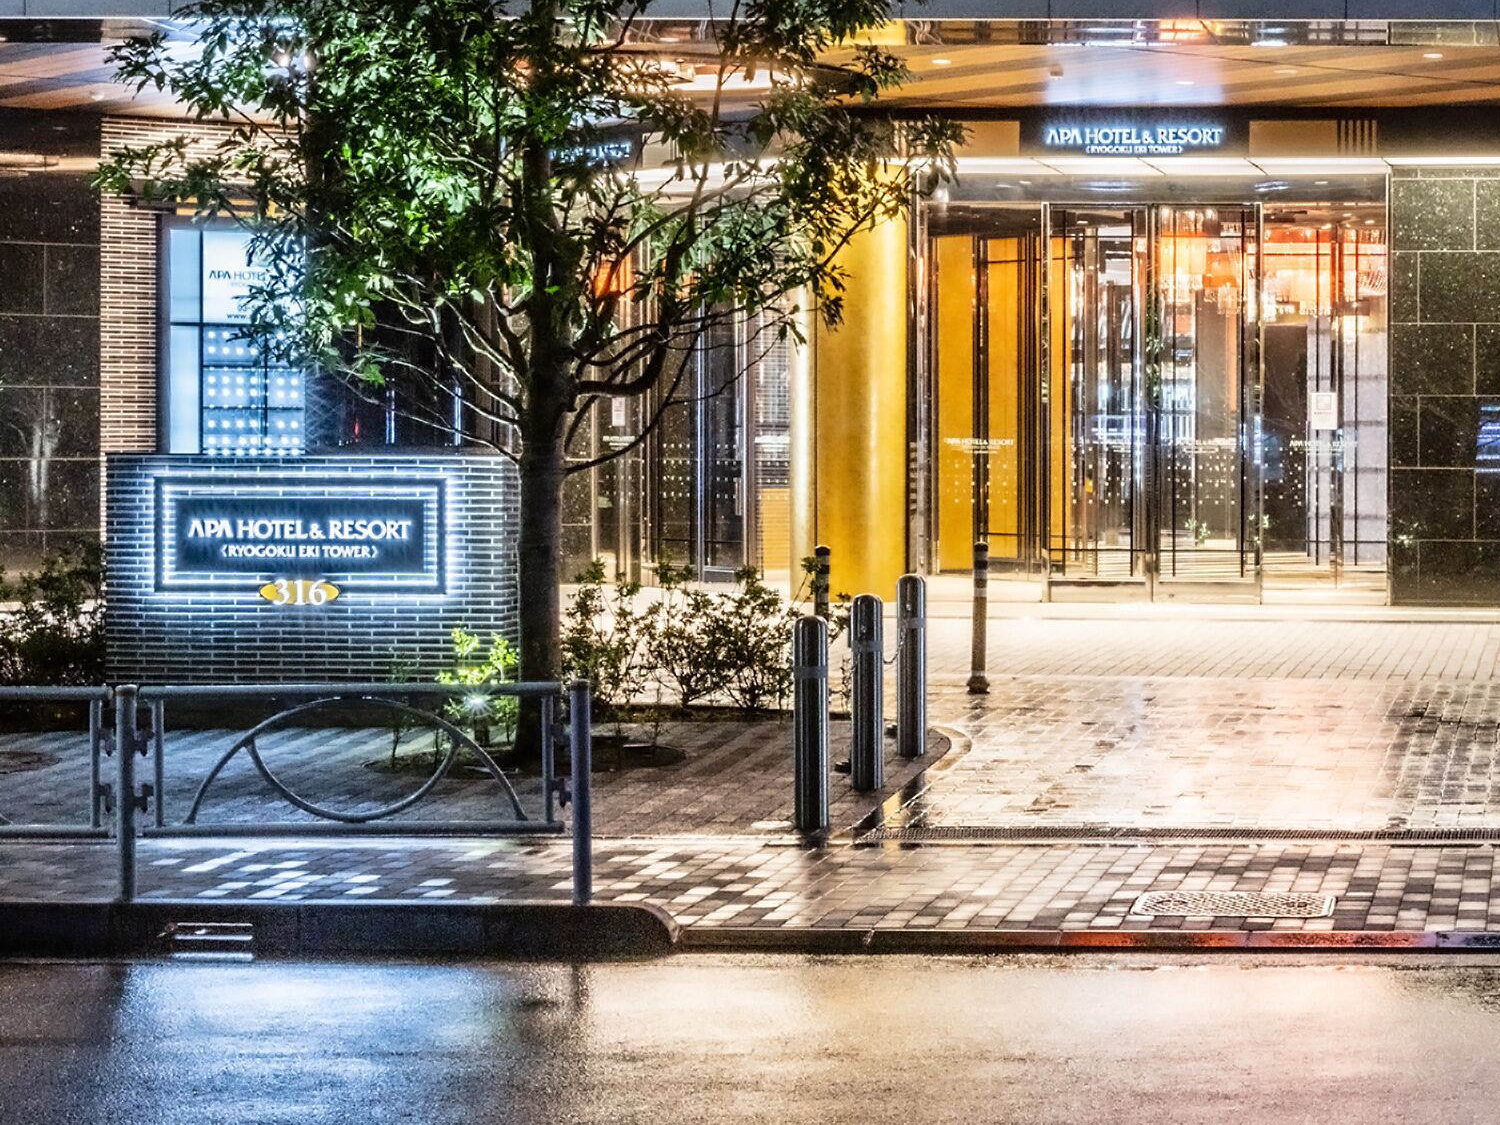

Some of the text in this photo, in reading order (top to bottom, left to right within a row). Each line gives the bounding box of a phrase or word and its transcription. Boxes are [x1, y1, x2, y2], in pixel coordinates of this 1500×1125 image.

[1046, 127, 1222, 144] APA HOTEL & RESORT
[209, 270, 231, 280] APA
[188, 520, 411, 539] APA HOTEL & RESORT
[299, 545, 319, 557] EKI
[273, 579, 327, 605] 316
